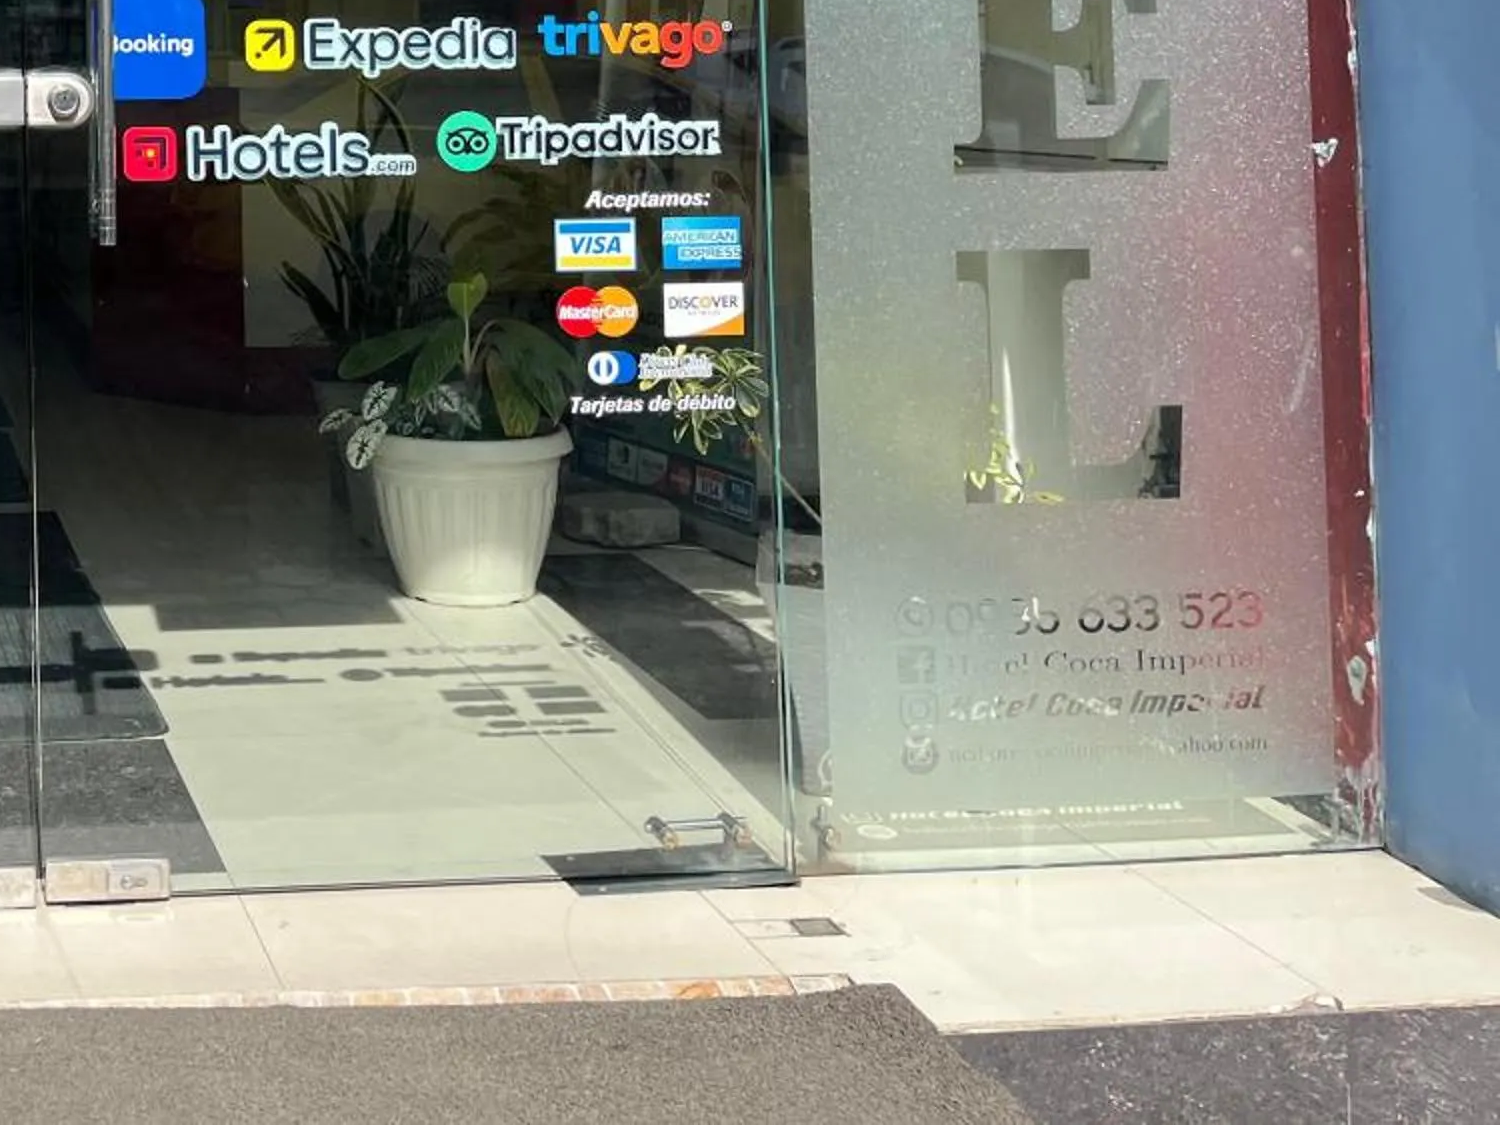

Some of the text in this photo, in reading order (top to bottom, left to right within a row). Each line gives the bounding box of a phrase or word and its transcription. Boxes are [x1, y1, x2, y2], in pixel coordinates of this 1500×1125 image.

[305, 19, 515, 77] Expedia
[538, 11, 724, 67] trivago
[501, 114, 721, 165] Tripadvisor
[584, 189, 711, 213] Aceptamos:
[570, 236, 622, 254] VISA
[663, 230, 735, 243] AMERICAN
[559, 304, 638, 321] MasterCard
[667, 294, 739, 310] DISCOVER
[569, 390, 737, 418] Tarjetas de débito
[1078, 592, 1161, 634] 633
[1177, 589, 1264, 631] 523
[1129, 685, 1267, 715] Impeial
